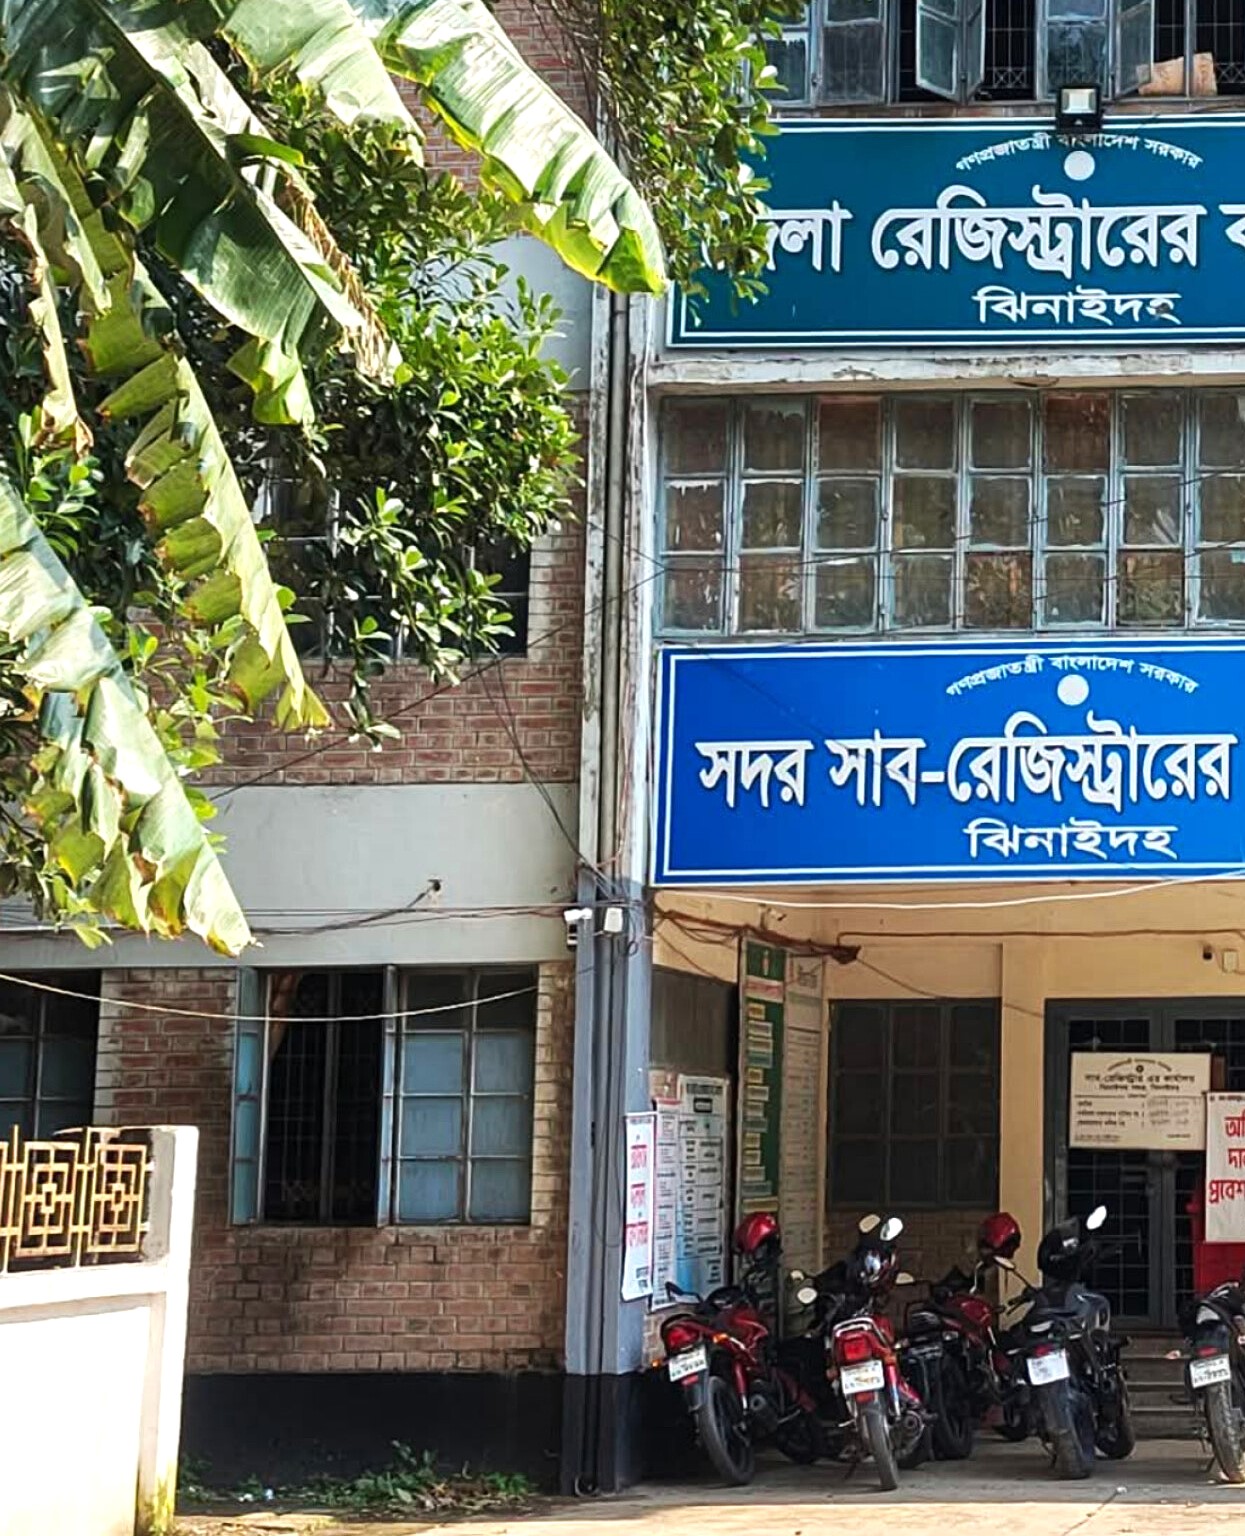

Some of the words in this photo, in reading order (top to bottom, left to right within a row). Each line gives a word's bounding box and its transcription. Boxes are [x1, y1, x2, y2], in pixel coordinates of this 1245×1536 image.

[1144, 138, 1203, 169] সরকার
[871, 184, 1208, 280] রেজিস্ট্রারের
[972, 285, 1182, 326] ঝিনাইদহ
[1048, 655, 1135, 675] বাংলাদেশ
[1140, 661, 1199, 694] সরকার
[695, 739, 814, 808] সদর
[824, 709, 1238, 813] সাব-রেজিস্ট্রারের
[963, 816, 1179, 860] ঝিনাইদহ
